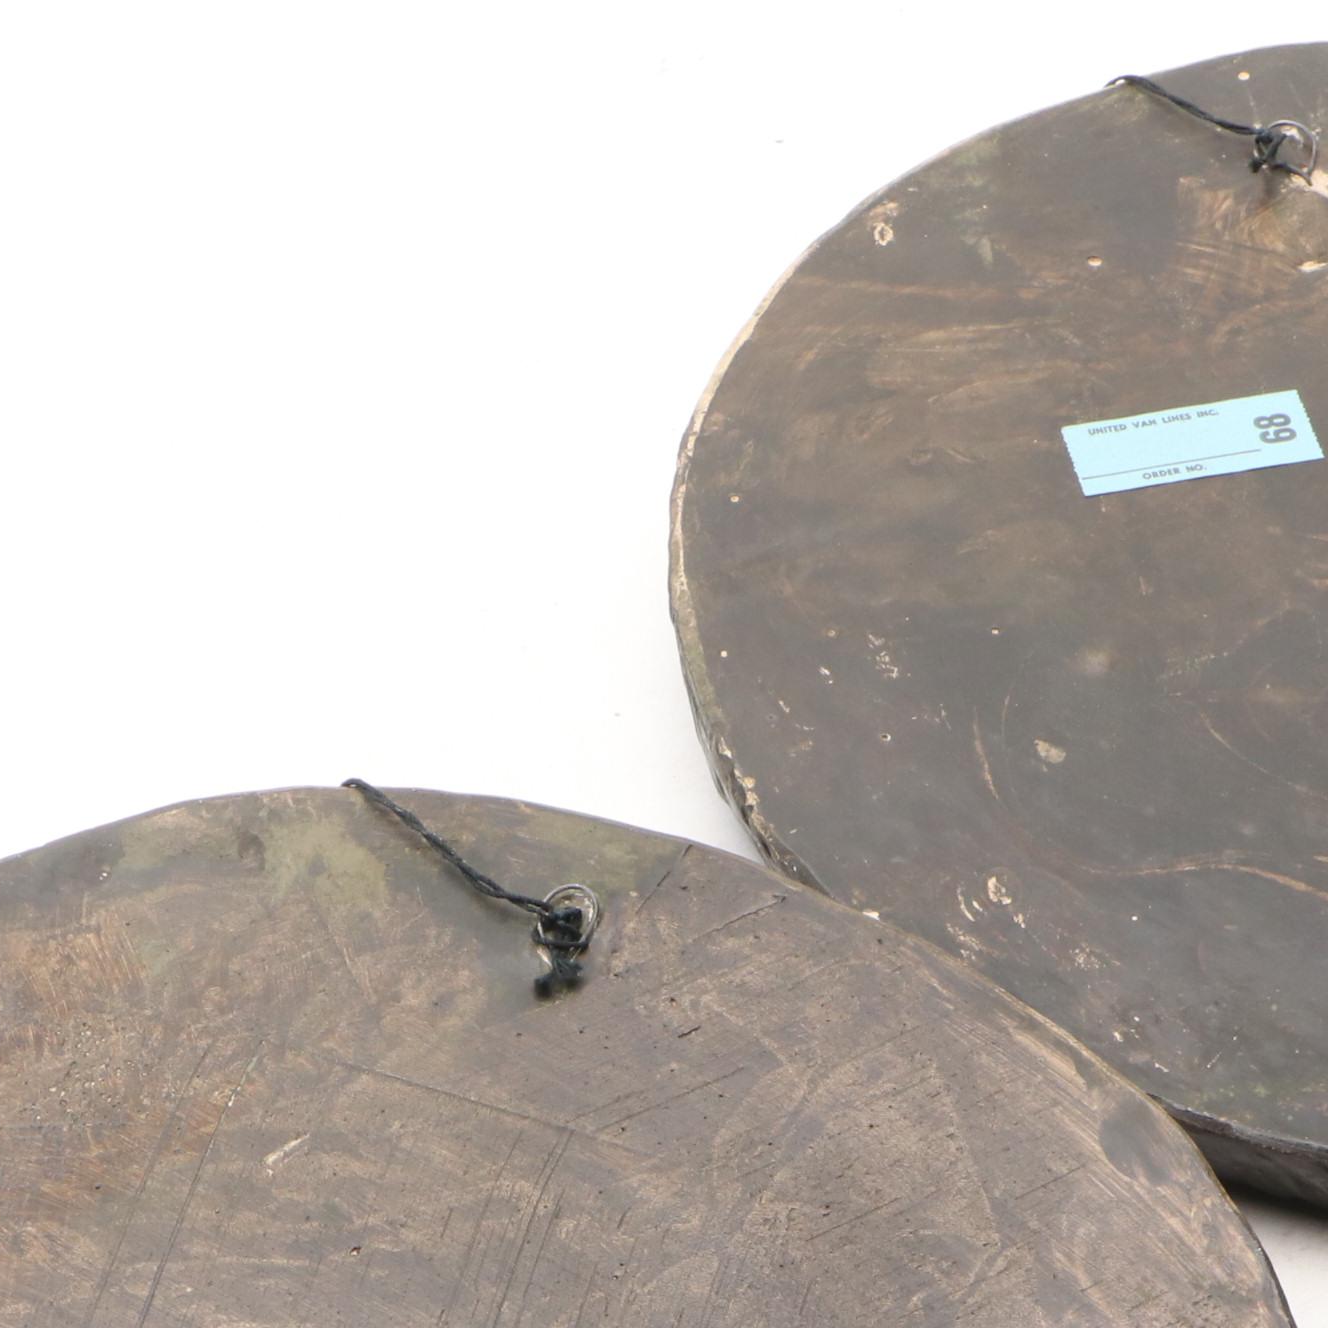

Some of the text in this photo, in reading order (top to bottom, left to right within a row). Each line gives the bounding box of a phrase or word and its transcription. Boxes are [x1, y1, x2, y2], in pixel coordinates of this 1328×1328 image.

[1087, 424, 1127, 436] UNITED
[1132, 418, 1158, 429] VAN
[1161, 413, 1192, 424] LINES
[1252, 412, 1298, 444] 68
[1142, 463, 1208, 480] ORDER NO.
